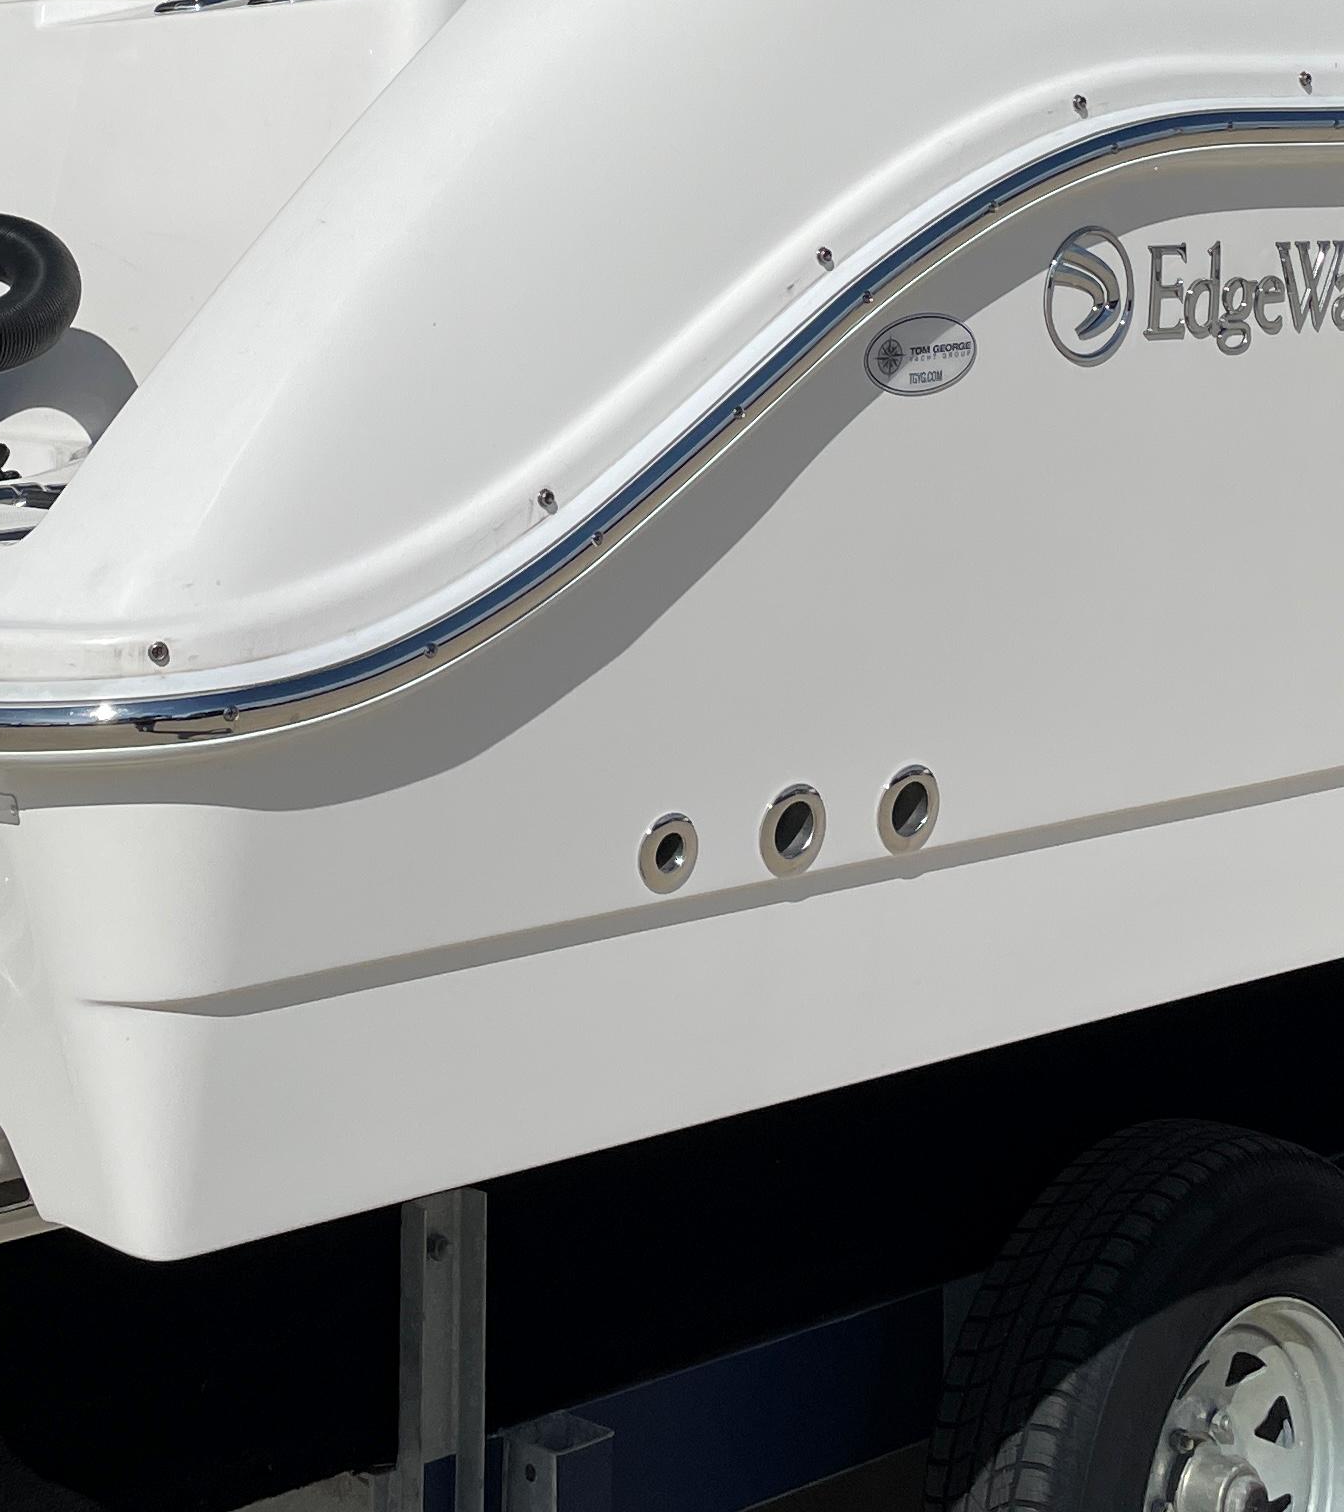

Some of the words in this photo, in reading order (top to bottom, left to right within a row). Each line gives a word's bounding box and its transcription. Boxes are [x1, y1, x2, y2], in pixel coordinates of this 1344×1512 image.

[910, 346, 931, 355] TOM
[933, 341, 971, 353] GEORGE
[909, 370, 942, 384] TGYG.COM
